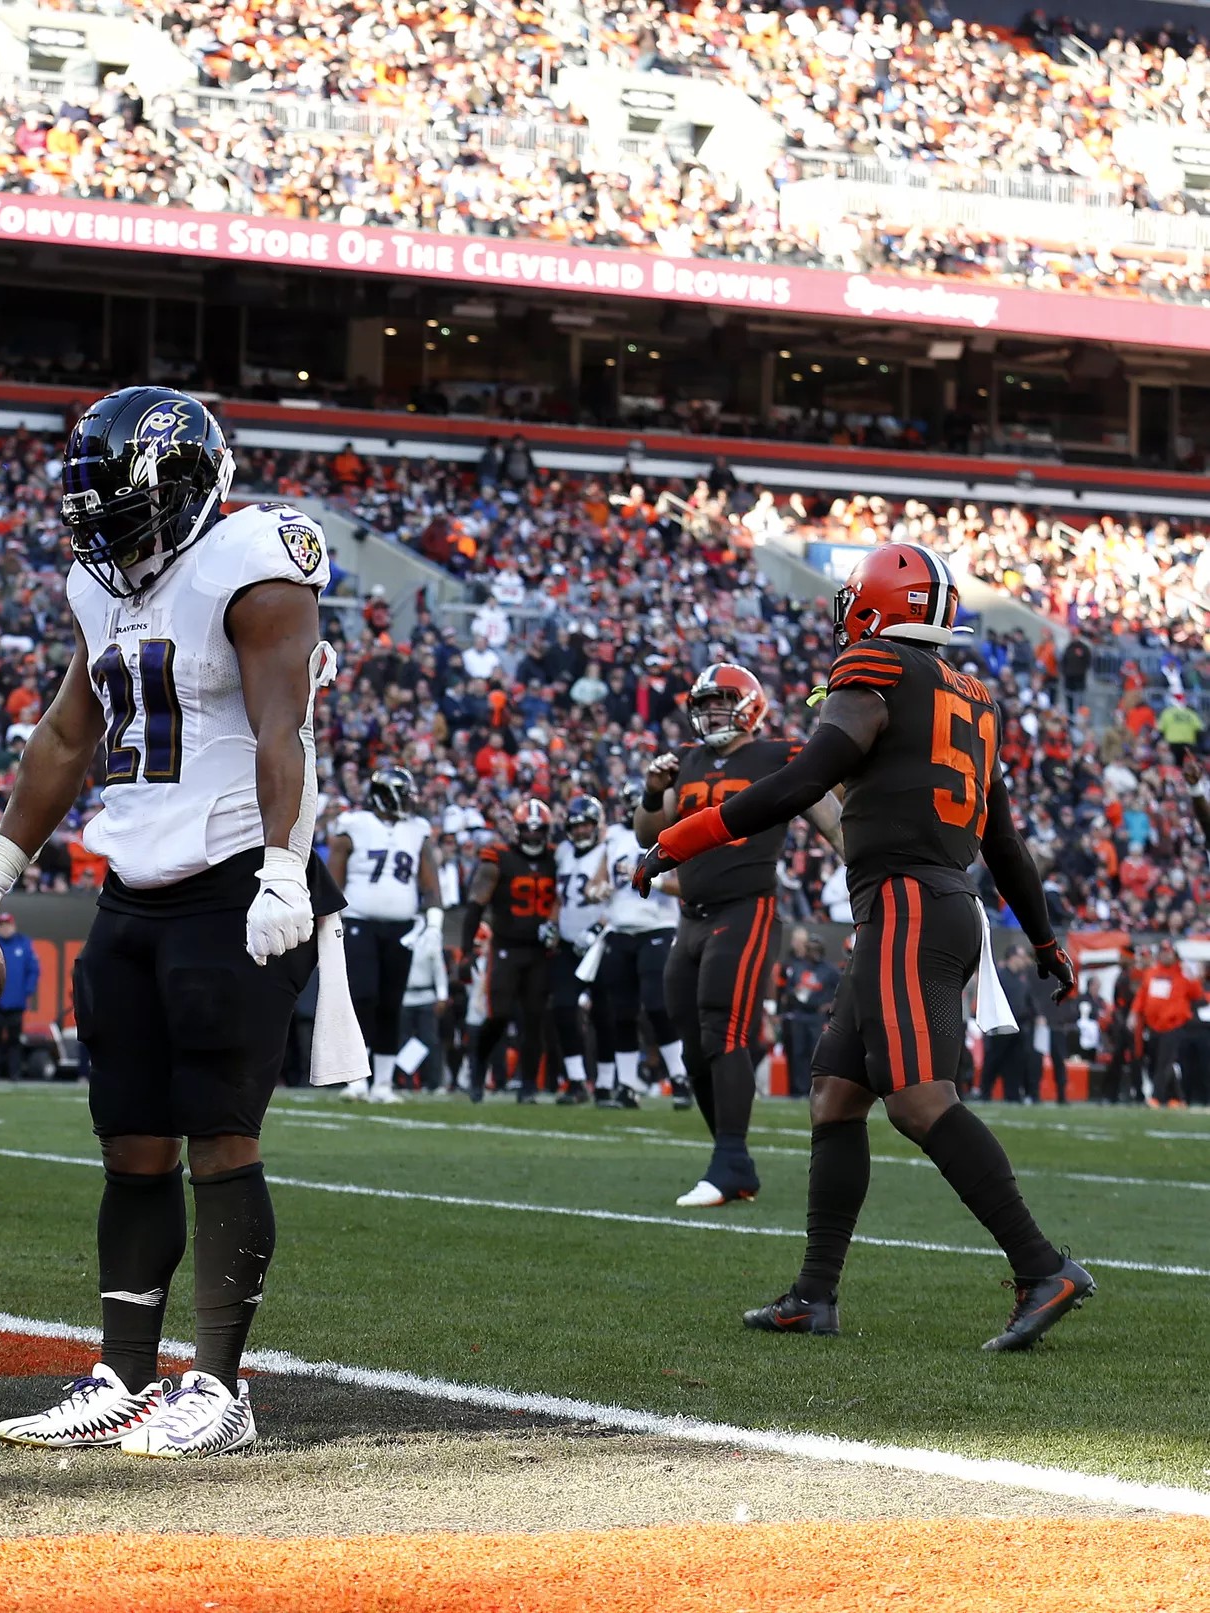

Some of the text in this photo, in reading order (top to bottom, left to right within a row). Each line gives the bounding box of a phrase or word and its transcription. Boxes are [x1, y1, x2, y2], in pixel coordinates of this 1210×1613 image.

[843, 275, 999, 327] Speedway
[115, 622, 148, 634] RAVENS
[91, 638, 183, 784] 21
[931, 687, 996, 841] 51
[367, 850, 413, 884] 78
